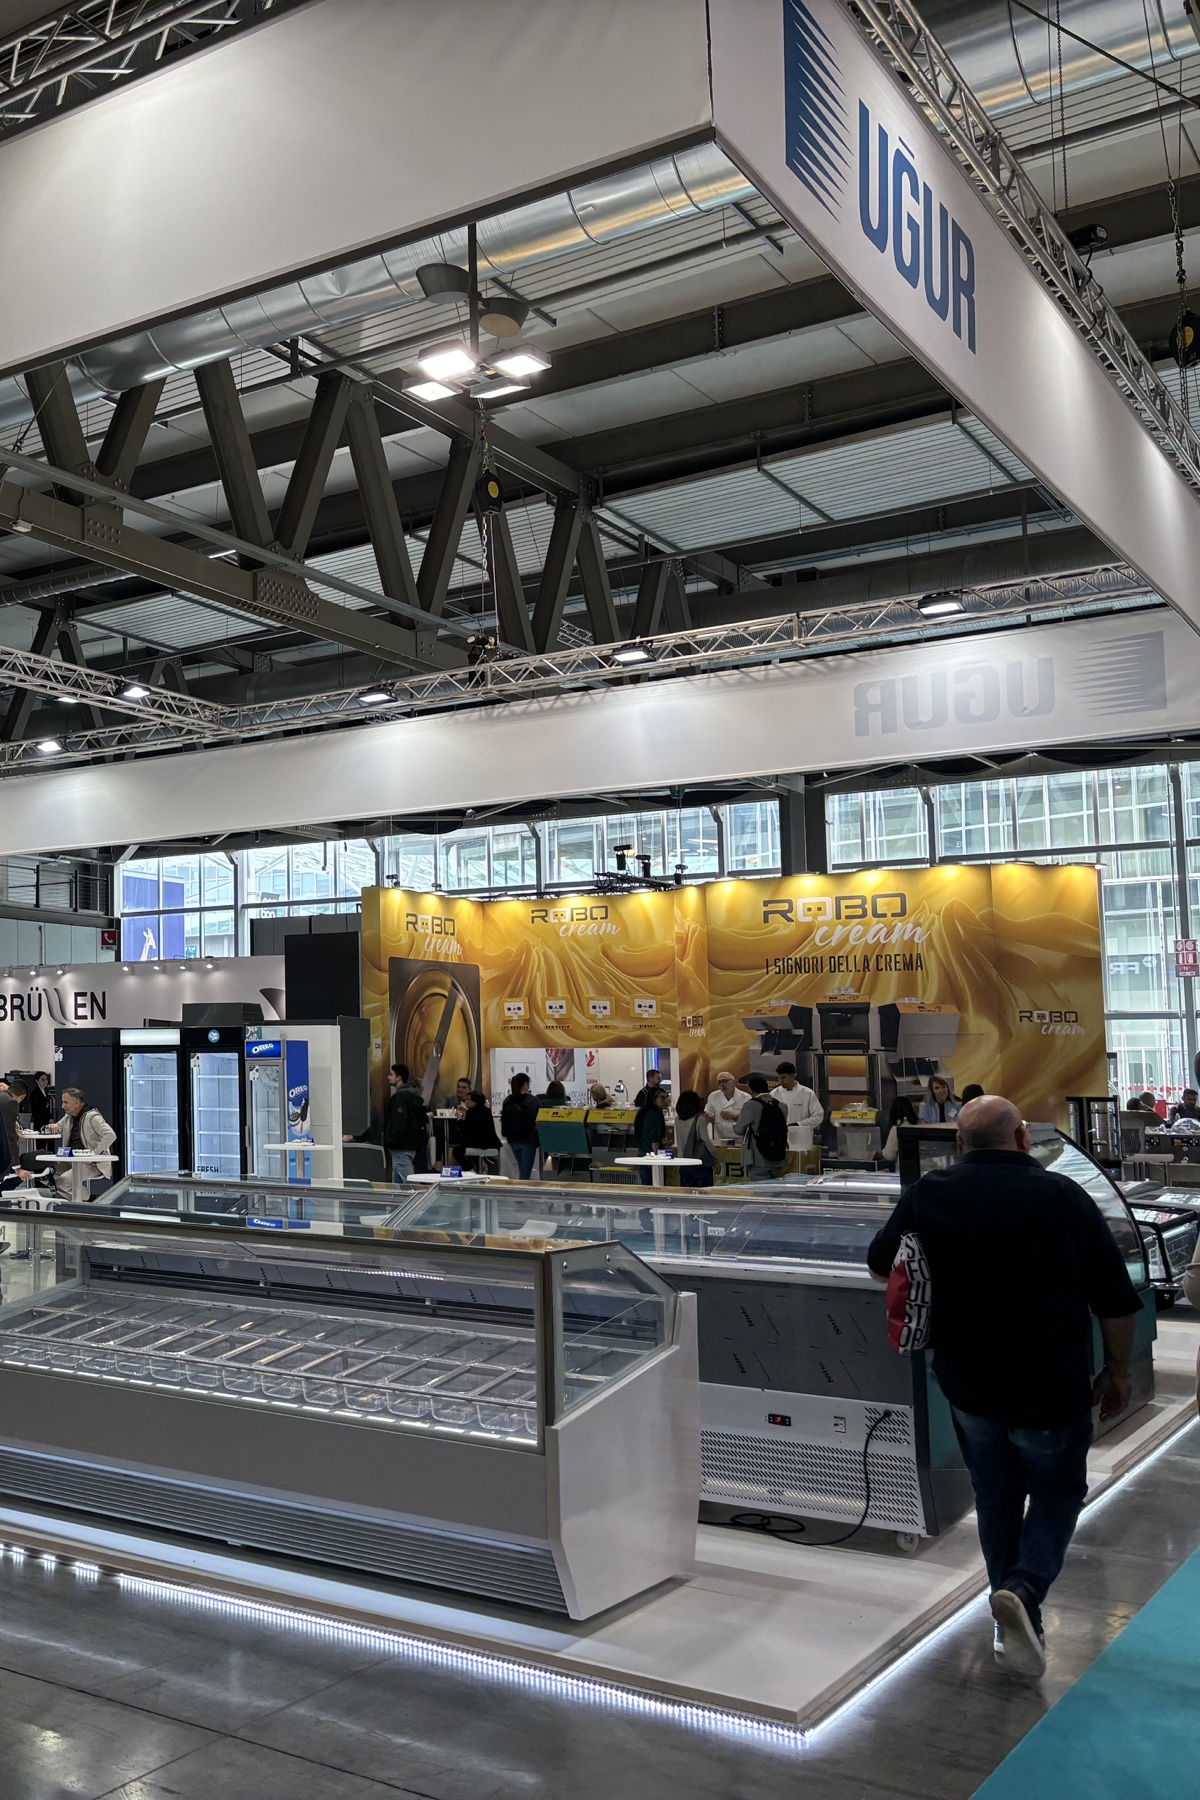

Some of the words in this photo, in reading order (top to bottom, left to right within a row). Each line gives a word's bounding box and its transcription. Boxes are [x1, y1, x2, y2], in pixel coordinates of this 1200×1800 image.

[530, 905, 609, 924] ROBO
[762, 892, 908, 924] ROBO
[405, 912, 456, 937] ROBO
[558, 921, 621, 937] cream
[814, 921, 932, 947] cream
[424, 936, 463, 956] cream
[765, 958, 770, 975] I
[774, 955, 824, 975] SIGNORI
[828, 954, 871, 973] DELLA
[875, 952, 925, 972] CREMA
[1018, 1010, 1079, 1024] ROBO
[251, 1042, 275, 1055] OREO
